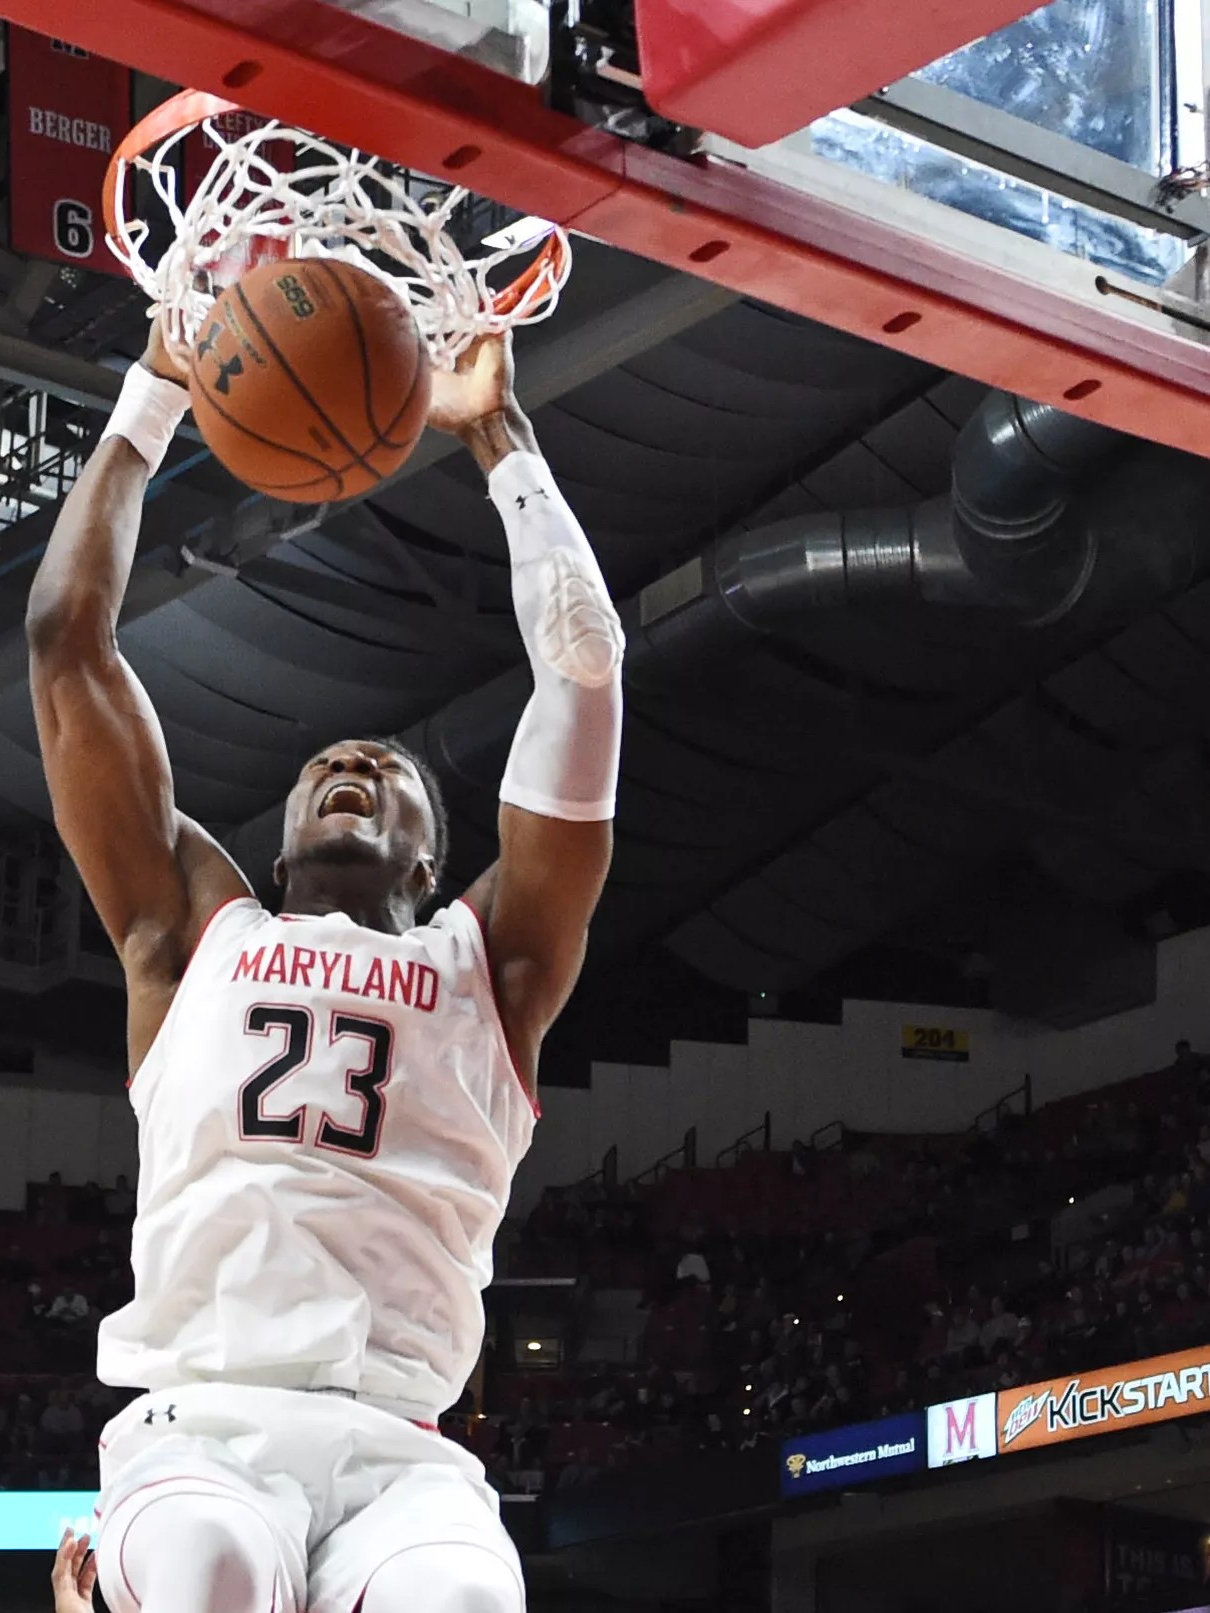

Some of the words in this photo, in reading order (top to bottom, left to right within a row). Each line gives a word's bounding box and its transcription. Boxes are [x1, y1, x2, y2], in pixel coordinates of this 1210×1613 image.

[29, 106, 112, 154] BERGER
[53, 199, 93, 259] 6
[230, 943, 439, 1012] MARYLAND
[913, 1027, 956, 1048] 204
[237, 1002, 395, 1159] 23
[806, 1454, 876, 1474] Northwestern
[877, 1437, 915, 1459] Mutual
[943, 1400, 978, 1456] M
